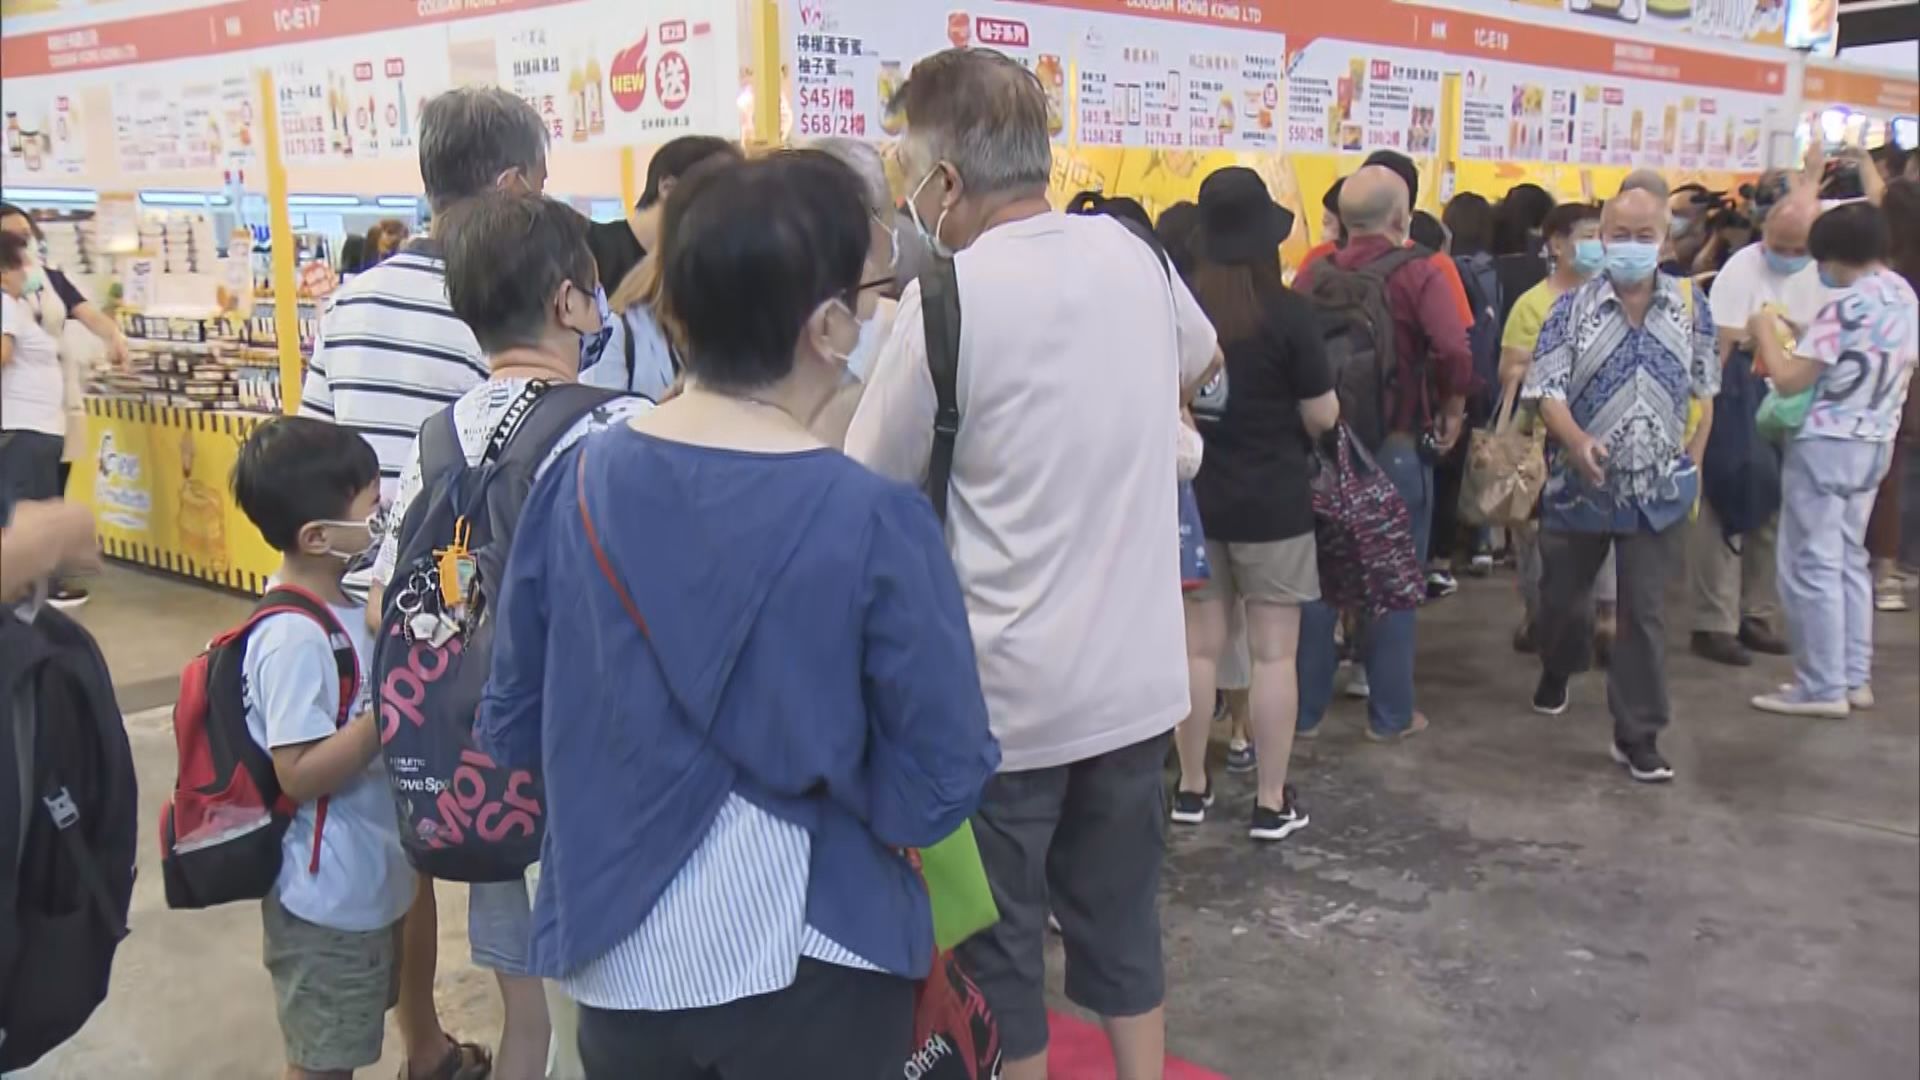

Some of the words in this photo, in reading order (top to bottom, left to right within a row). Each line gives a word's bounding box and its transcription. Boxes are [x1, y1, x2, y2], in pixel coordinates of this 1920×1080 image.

[1242, 7, 1262, 23] LTD
[980, 20, 1027, 43] 柚子系列
[798, 56, 837, 76] 柚子蜜
[612, 72, 647, 94] NEW
[658, 57, 688, 102] 送
